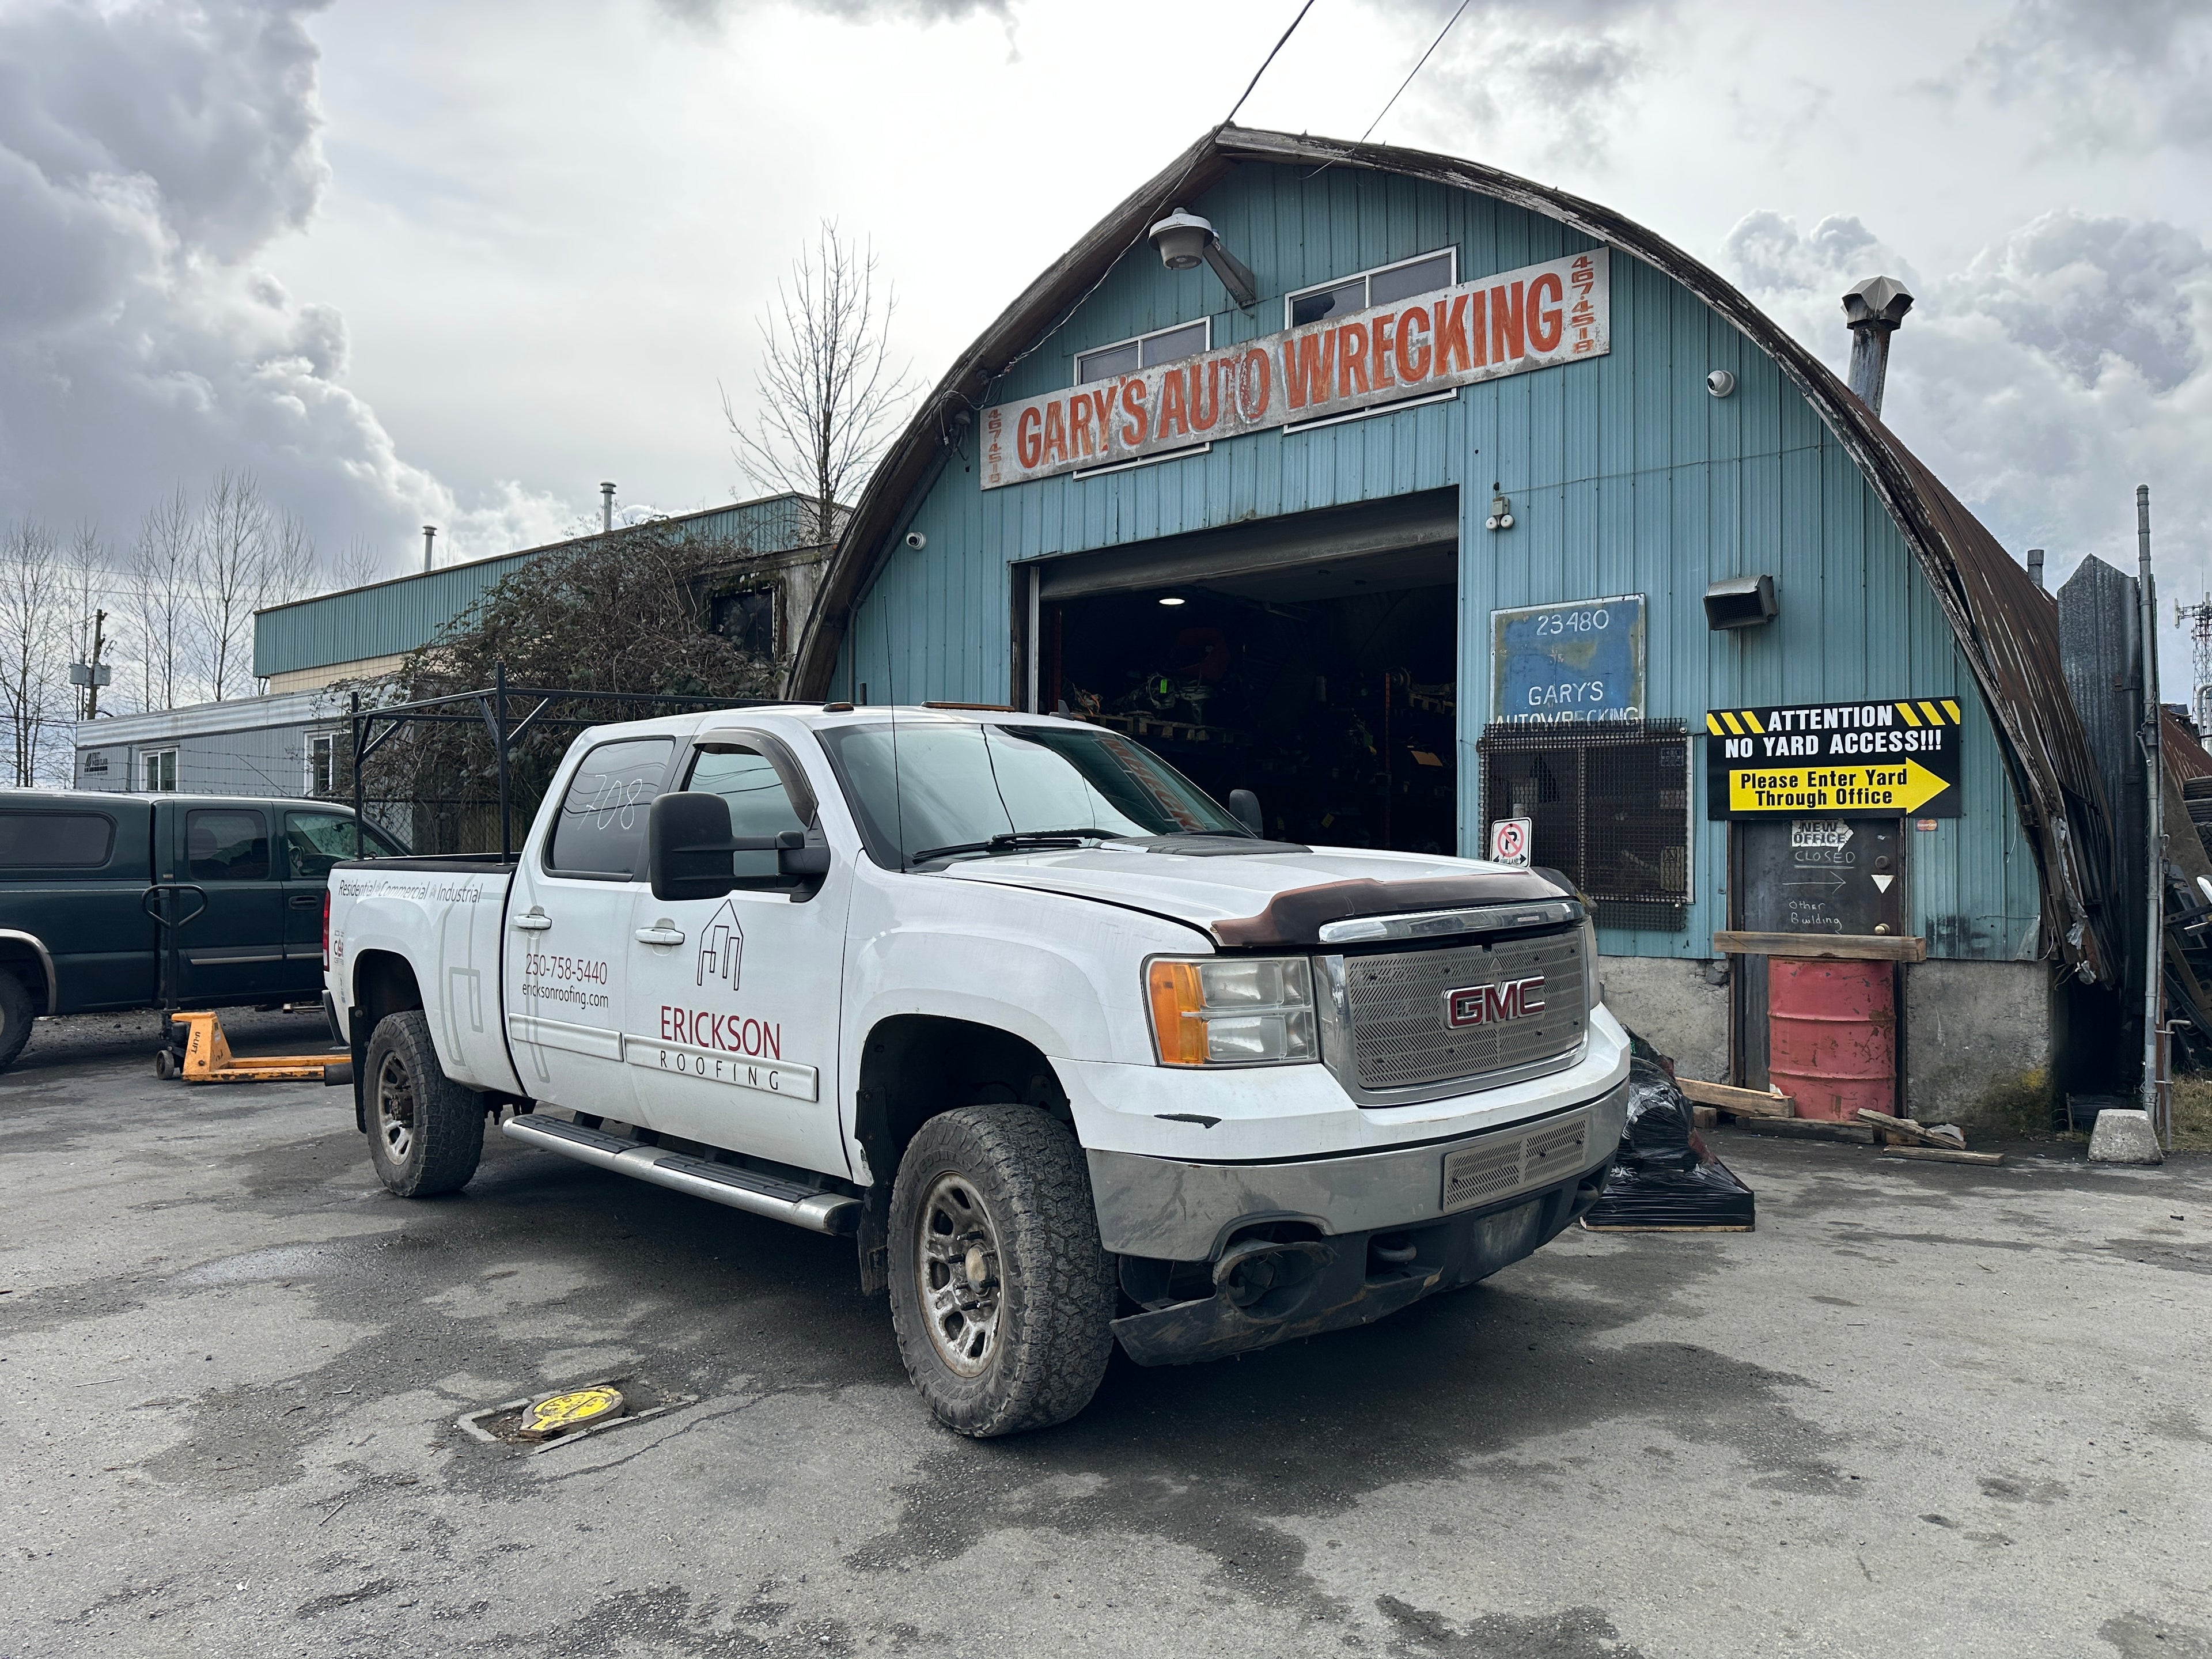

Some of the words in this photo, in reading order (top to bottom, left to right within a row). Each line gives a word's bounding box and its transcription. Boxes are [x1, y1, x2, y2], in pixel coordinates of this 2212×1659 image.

[1017, 376, 1147, 469] GARY'S
[1158, 348, 1271, 440] AUTO
[1283, 272, 1564, 409] WRECKING
[1536, 608, 1609, 636] 23480
[1528, 681, 1604, 706] GARY'S
[1768, 704, 1892, 732] ATTENTION
[1725, 738, 1753, 758] NO
[1763, 735, 1819, 756] YARD
[1829, 729, 1942, 755] ACCESS!!!
[1741, 772, 1798, 789] Please
[1808, 771, 1856, 787] Enter
[1865, 768, 1907, 786] Yard
[577, 775, 642, 830] 708
[1755, 790, 1827, 808] Through
[1836, 789, 1893, 805] Office
[1793, 832, 1847, 844] OFFICE
[1800, 821, 1838, 832] NEW
[1795, 850, 1855, 863] CLOSED
[339, 879, 375, 896] Residential
[378, 881, 430, 900] Commercial
[437, 883, 483, 903] Industrial
[1791, 912, 1842, 931] Building
[525, 953, 607, 984] 250-758-5440
[522, 980, 608, 1009] ericksonroofing.com
[1443, 976, 1545, 1030] GMC
[191, 1031, 200, 1054] U-LIFT
[661, 1005, 780, 1060] ERICKSON
[660, 1050, 779, 1090] ROOFING
